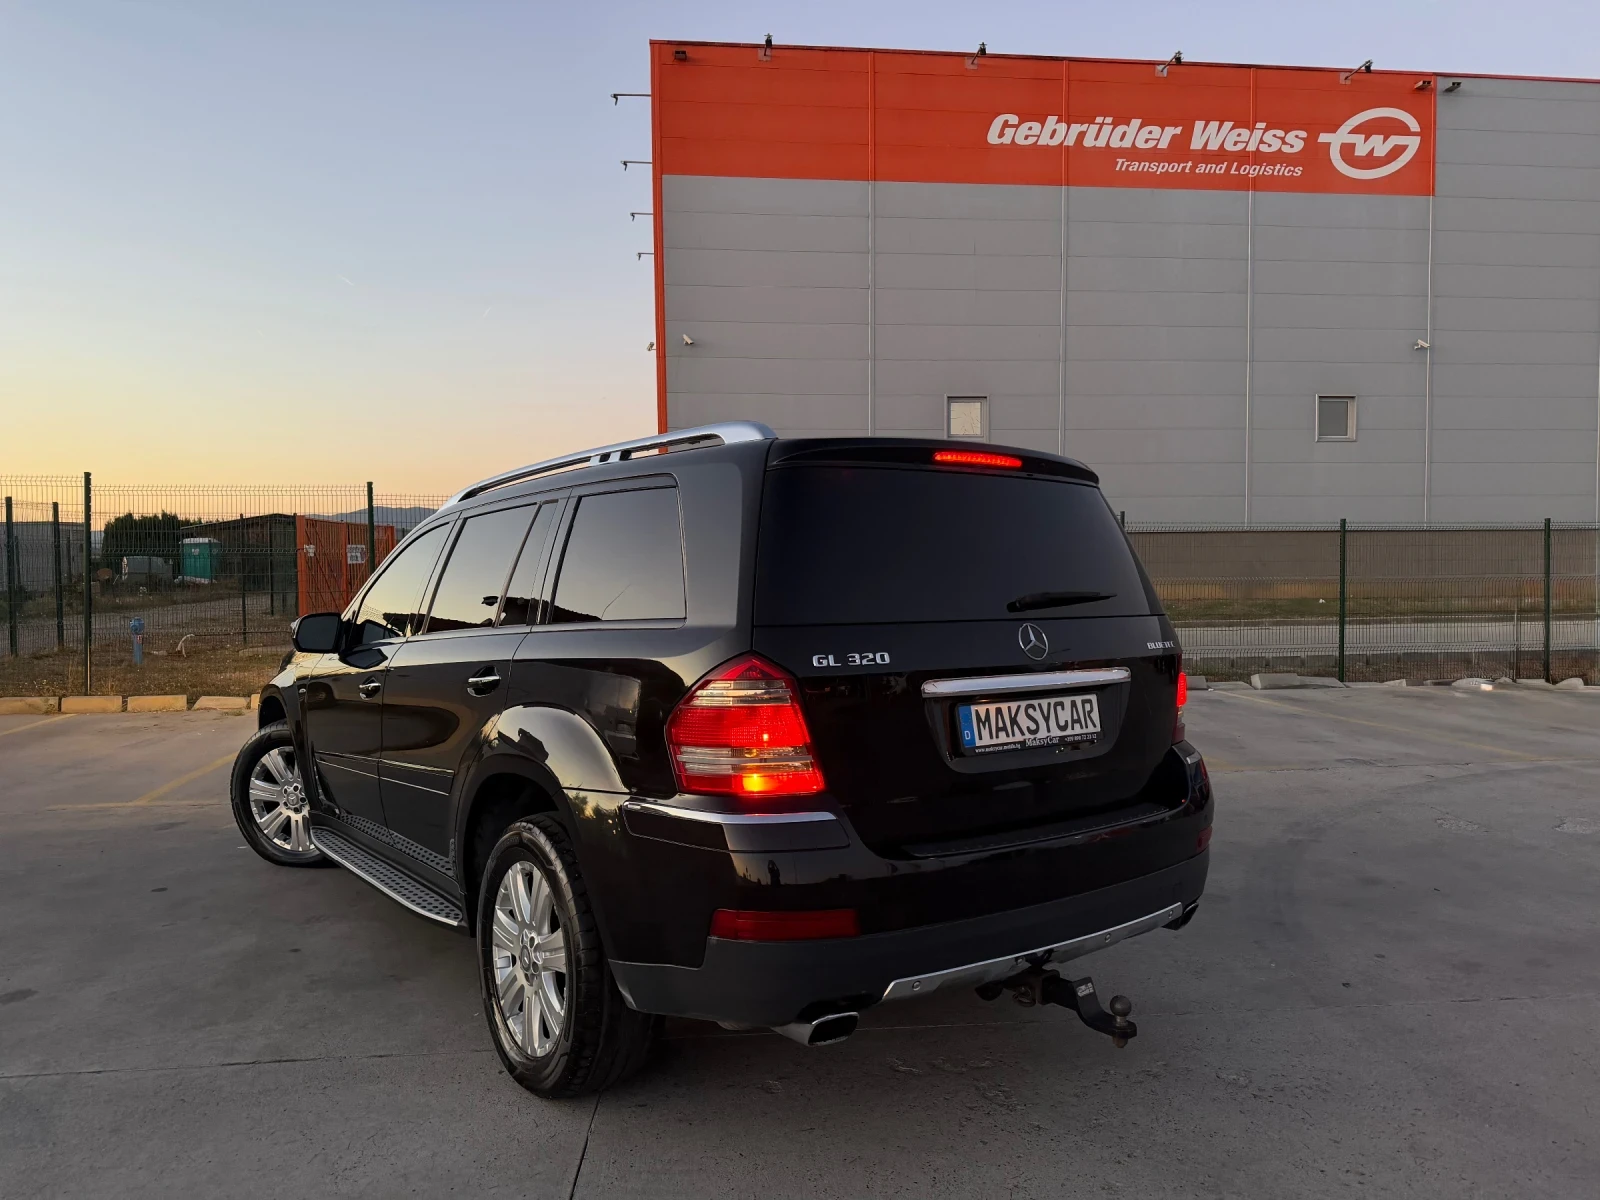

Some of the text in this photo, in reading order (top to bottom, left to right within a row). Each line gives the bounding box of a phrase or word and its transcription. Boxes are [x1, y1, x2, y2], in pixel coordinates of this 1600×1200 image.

[986, 113, 1308, 154] Gebrüder Weiss
[1115, 158, 1304, 178] Transport and Logistics
[812, 652, 891, 667] GL 320
[974, 698, 1097, 741] MAKSYCAR
[964, 730, 971, 740] D
[1025, 735, 1060, 747] MaksyCar
